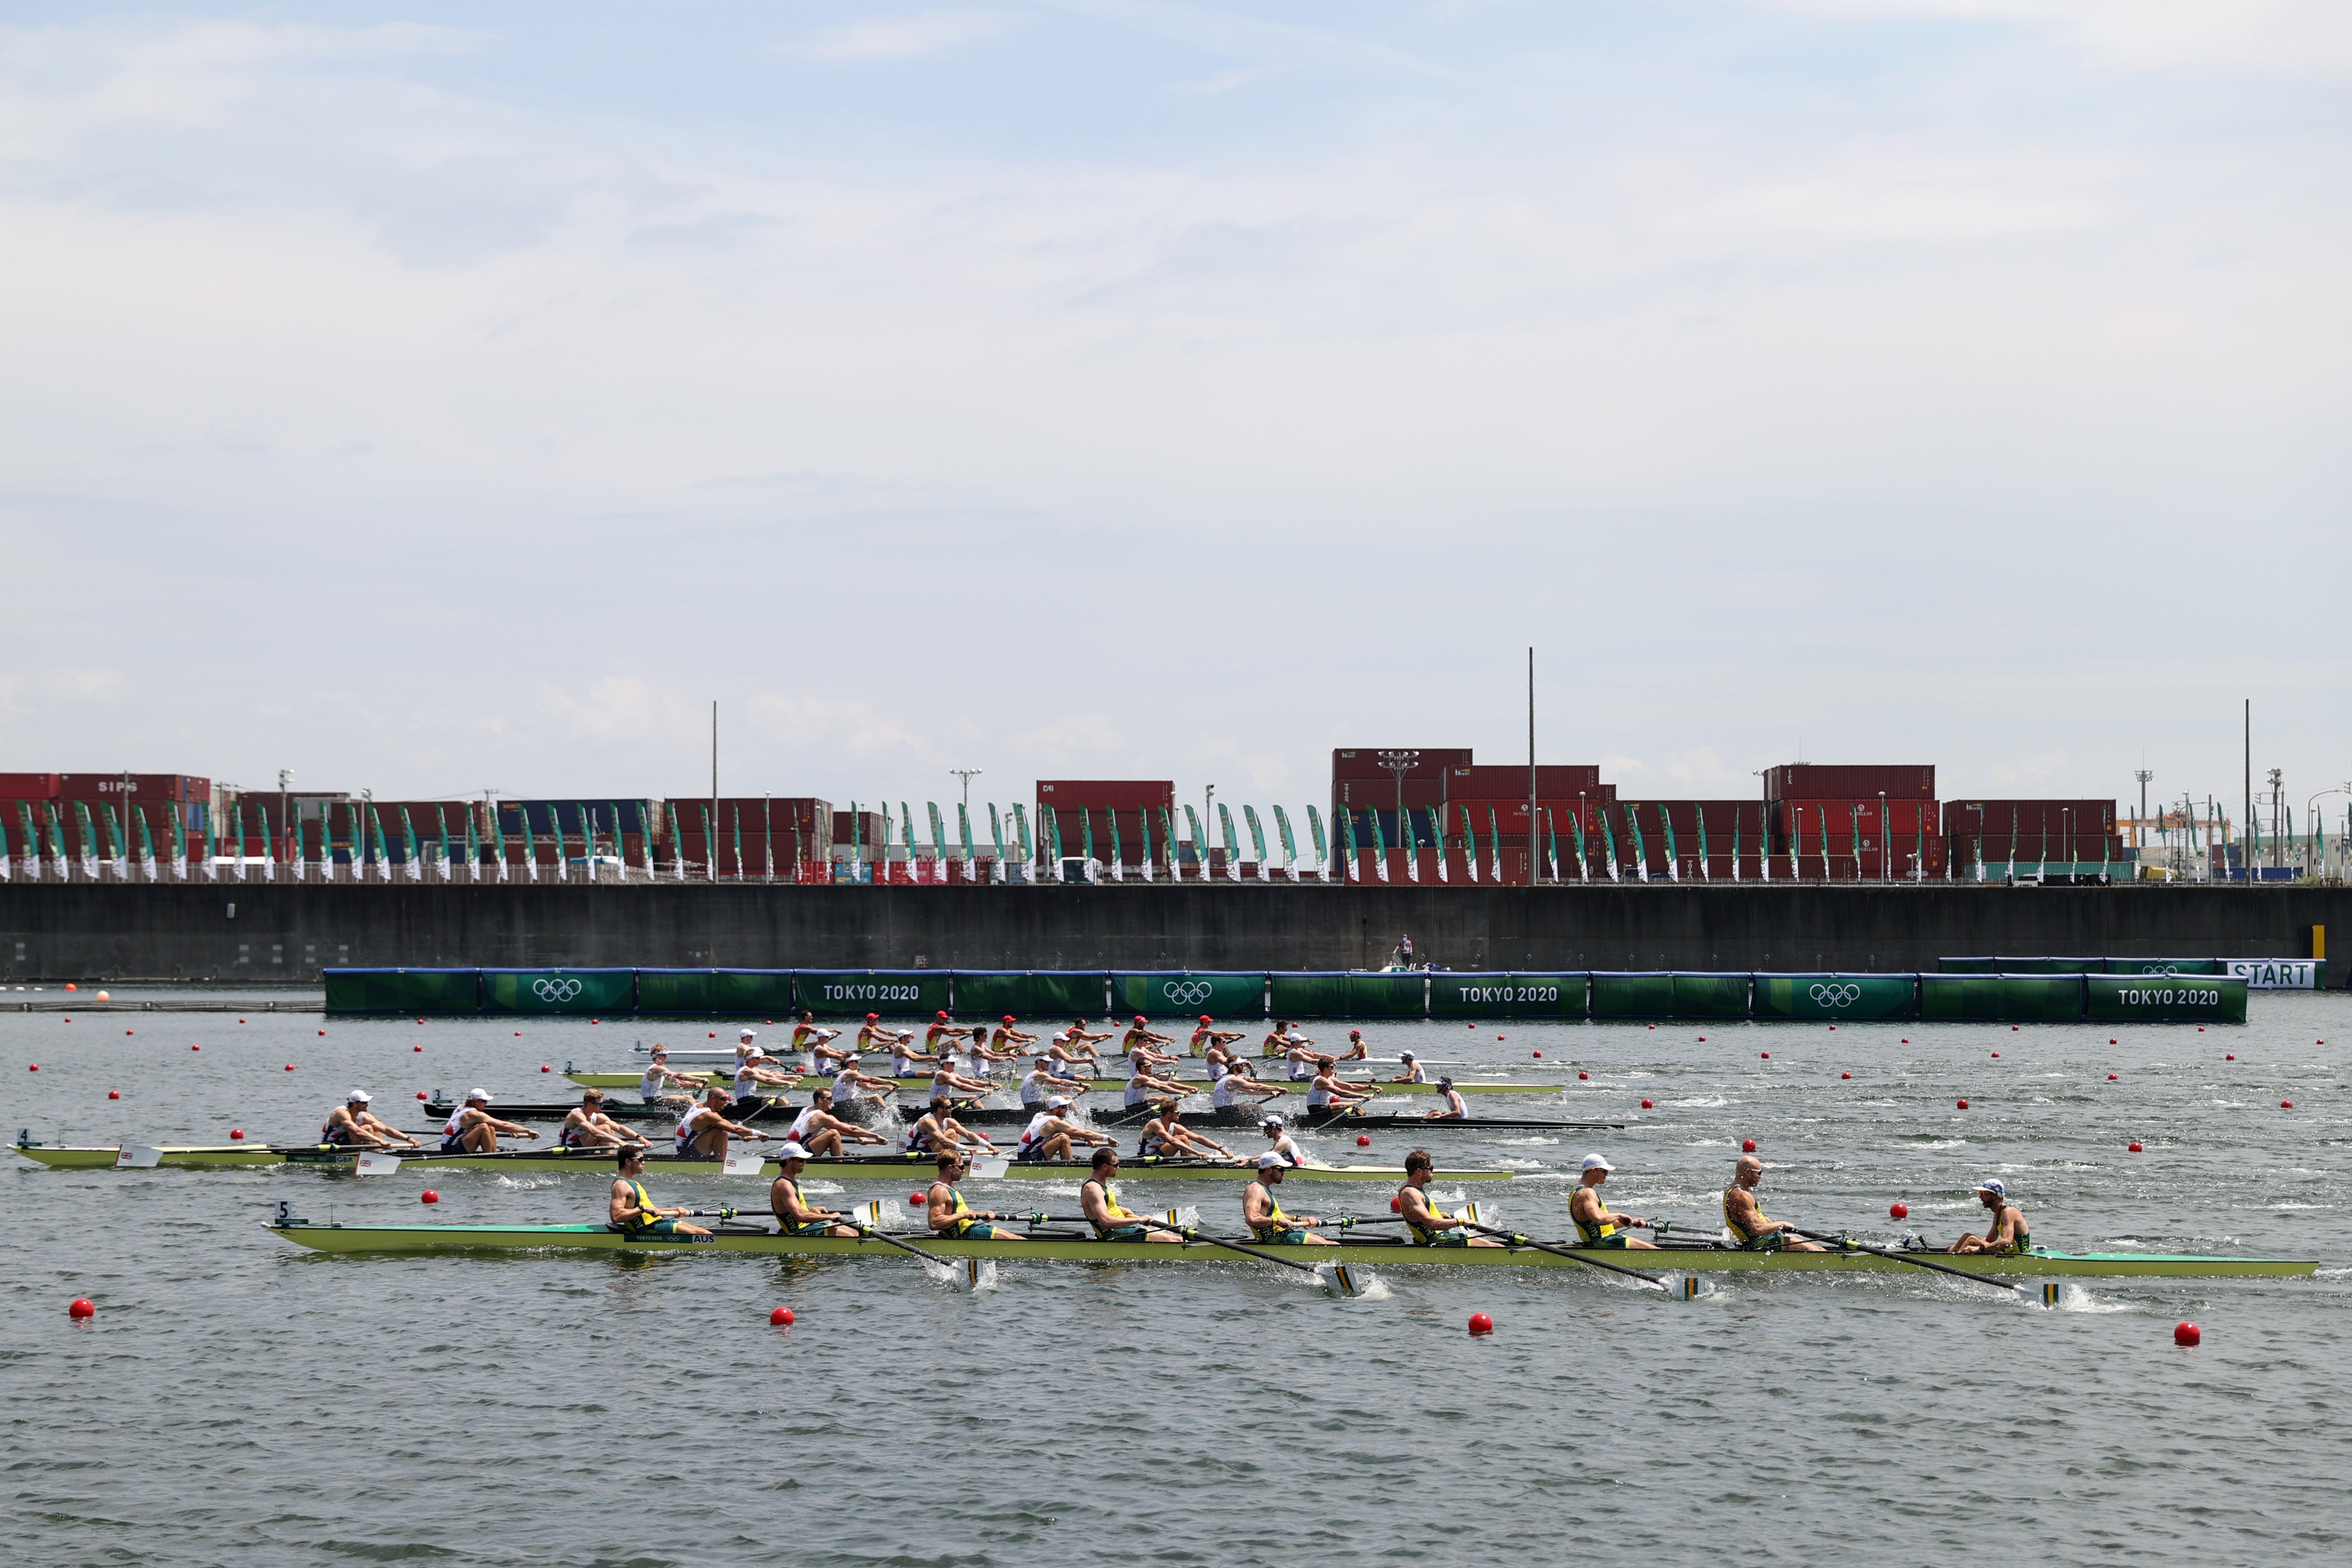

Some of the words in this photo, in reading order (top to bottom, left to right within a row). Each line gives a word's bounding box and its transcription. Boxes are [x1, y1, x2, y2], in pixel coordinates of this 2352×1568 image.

[2234, 964, 2308, 984] START
[824, 985, 876, 1000] TOKYO
[880, 985, 919, 1000] 2020
[1460, 987, 1513, 1002] TOKYO
[1517, 987, 1557, 1002] 2020
[2118, 989, 2173, 1005] TOKYO
[2177, 989, 2218, 1005] 2020
[567, 1061, 572, 1070] 2
[435, 1089, 440, 1100] 3
[21, 1129, 27, 1141] 4
[280, 1202, 288, 1218] 5
[633, 1218, 644, 1229] AU
[785, 1214, 797, 1229] AUS
[950, 1227, 959, 1238] AU
[1587, 1222, 1599, 1237] AUS
